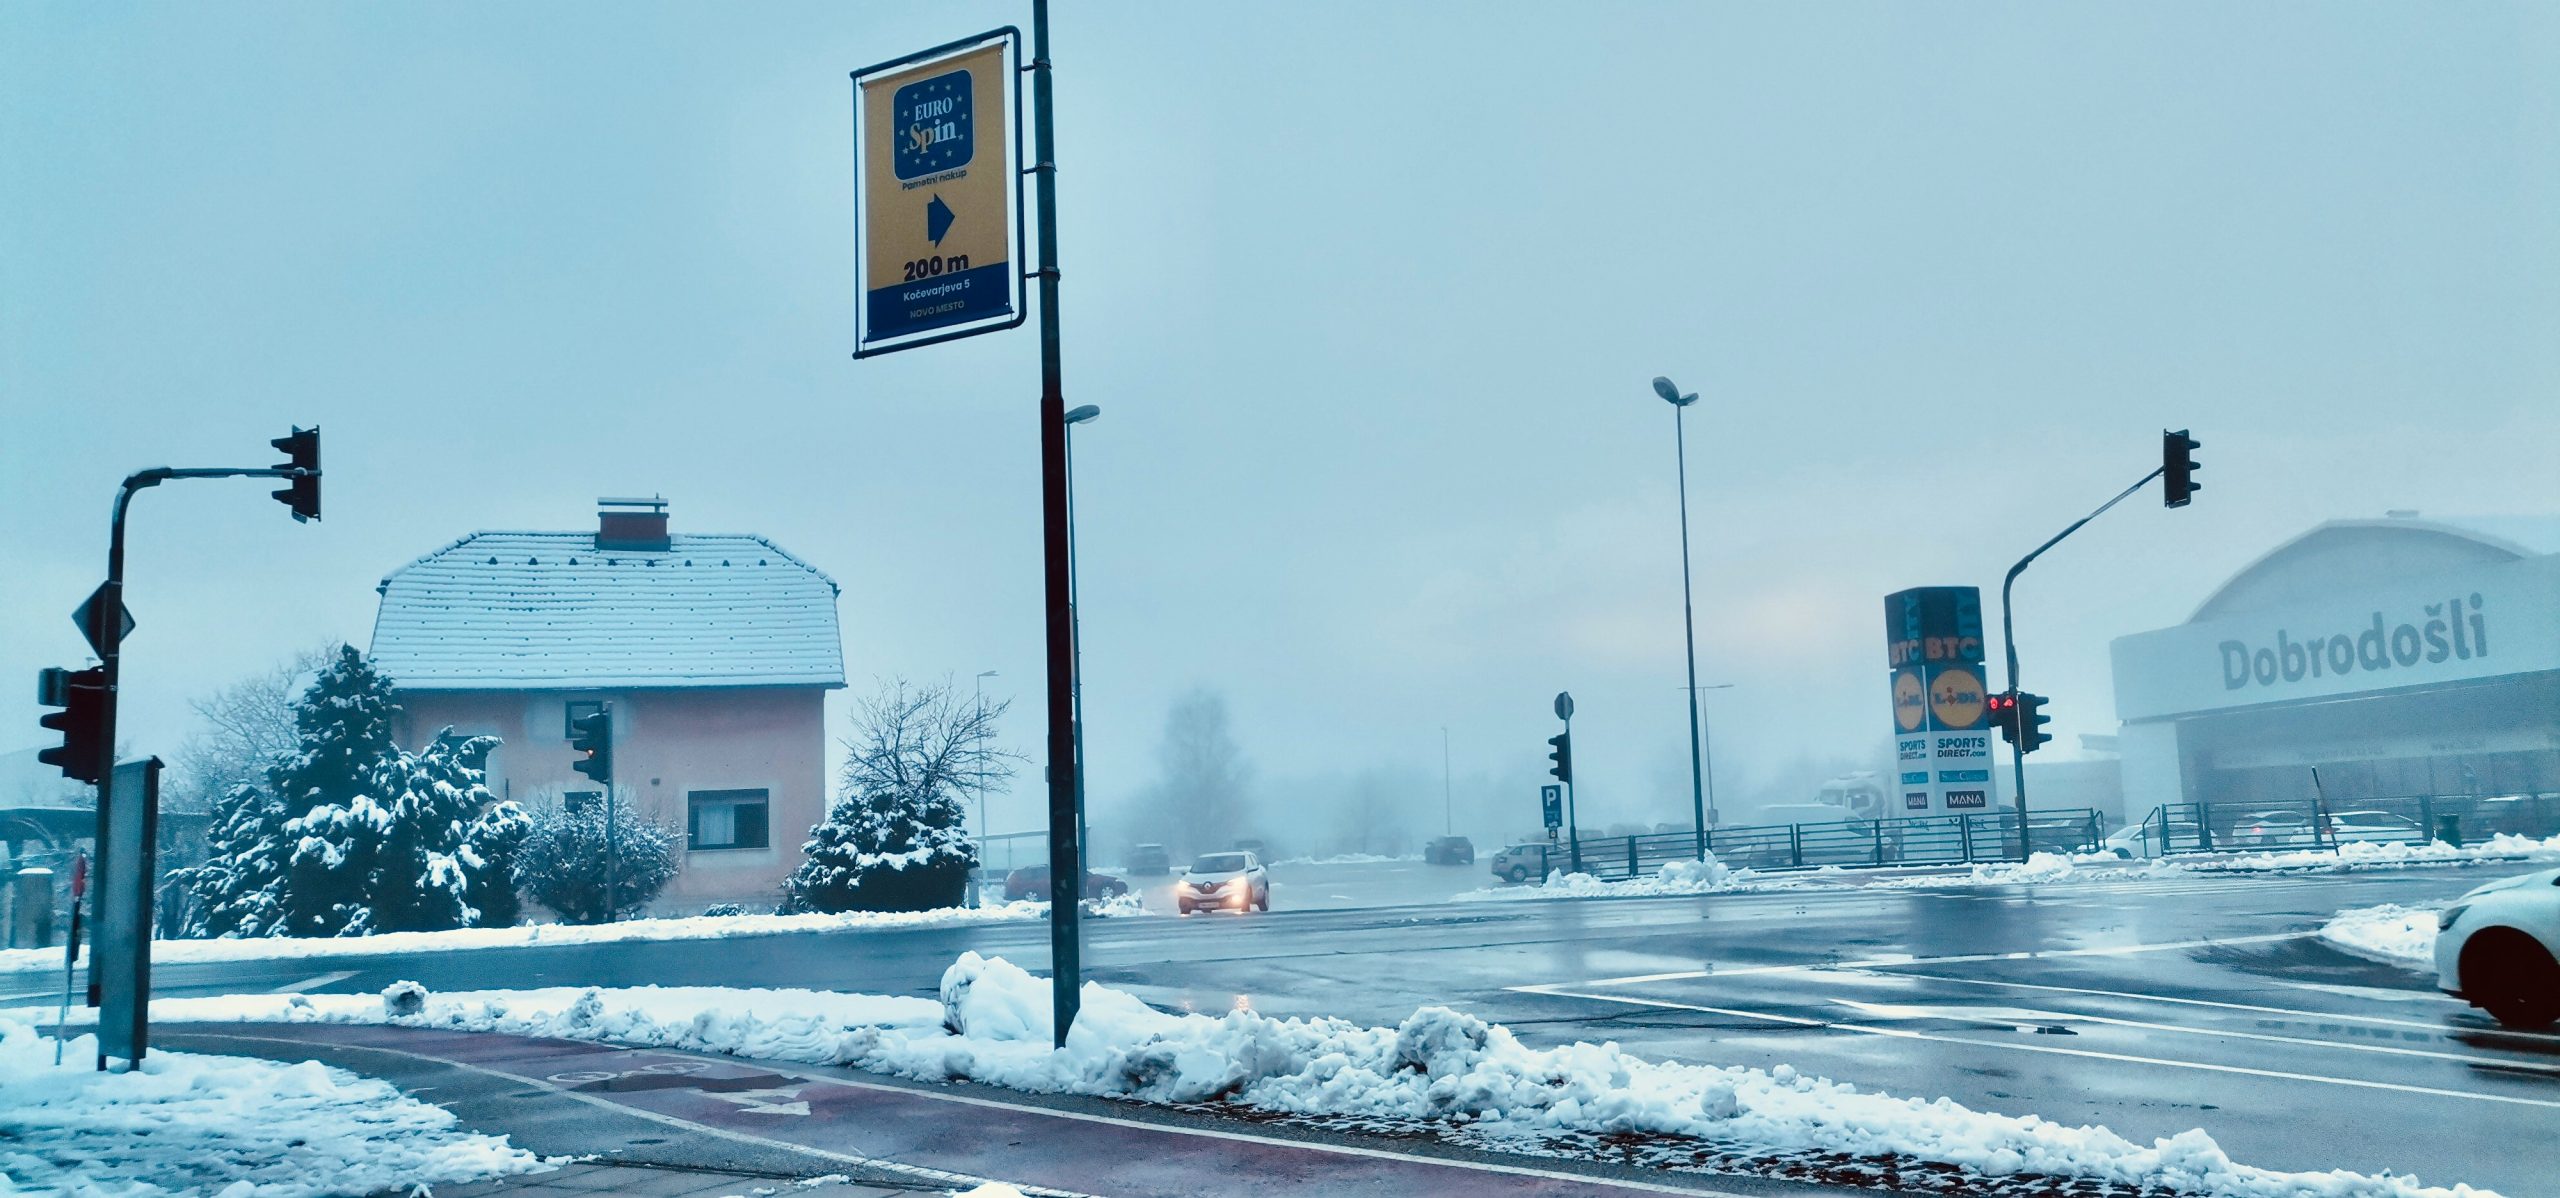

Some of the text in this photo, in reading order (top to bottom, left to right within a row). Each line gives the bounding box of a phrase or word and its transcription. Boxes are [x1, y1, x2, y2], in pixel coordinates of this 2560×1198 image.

[914, 97, 953, 121] EURO
[909, 118, 957, 154] Spin
[902, 169, 968, 191] Pametni nakup
[904, 254, 969, 281] 200 m
[903, 278, 971, 302] Kočevarjeva 5
[910, 300, 965, 319] NOVO MESTO
[1925, 636, 1978, 659] BTC
[2219, 592, 2488, 691] Dobrodošli
[1900, 739, 1926, 752] SPORTS
[1937, 737, 1985, 749] SPORTS
[1545, 788, 1557, 806] P
[1907, 796, 1926, 806] MANA
[1949, 793, 1983, 805] MANA
